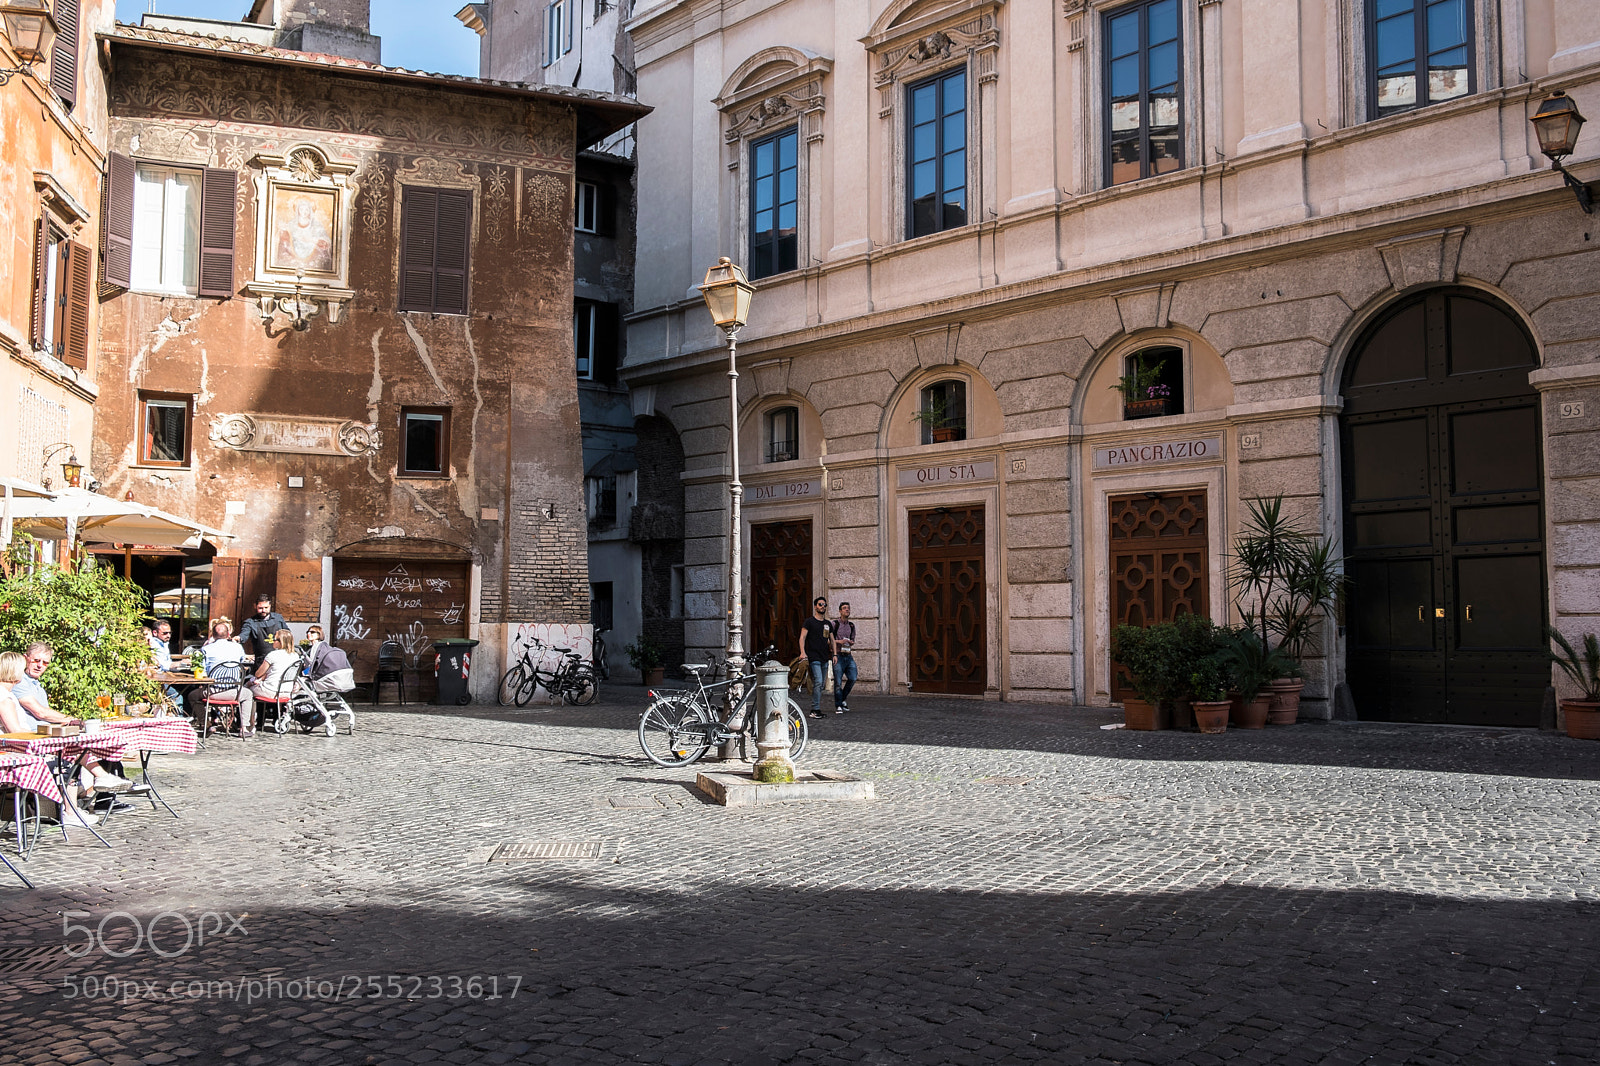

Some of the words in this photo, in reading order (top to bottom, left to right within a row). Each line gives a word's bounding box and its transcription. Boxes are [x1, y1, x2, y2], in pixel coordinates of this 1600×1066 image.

[1562, 404, 1581, 417] 95
[1243, 435, 1258, 447] 94
[1107, 441, 1207, 465] PANCRAZIO
[916, 467, 940, 483] QUI
[949, 464, 976, 479] STA
[1014, 461, 1025, 472] 93
[756, 485, 777, 499] DAL
[784, 482, 810, 497] 1922
